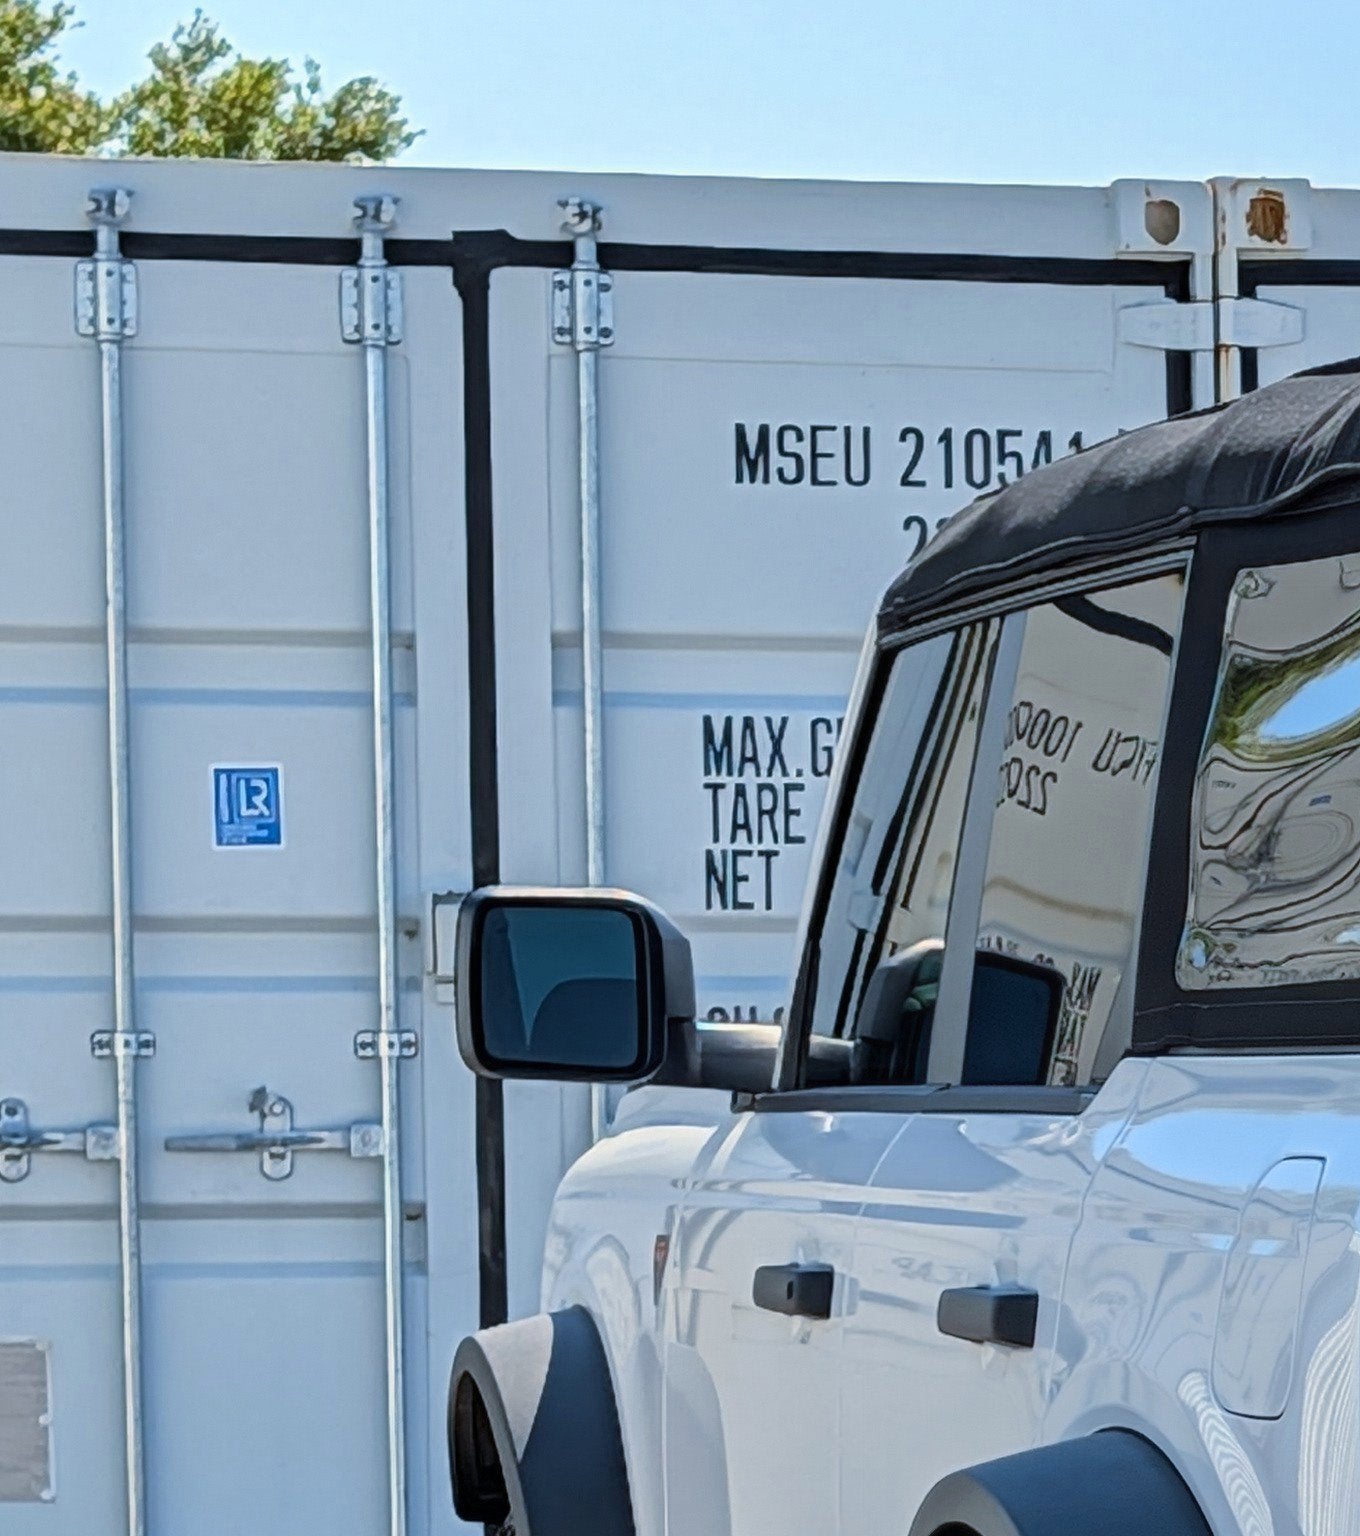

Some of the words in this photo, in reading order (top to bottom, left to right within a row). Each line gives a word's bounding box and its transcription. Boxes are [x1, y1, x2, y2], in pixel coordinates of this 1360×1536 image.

[734, 422, 871, 488] MSEU
[703, 782, 807, 845] TARE
[704, 848, 781, 911] NET
